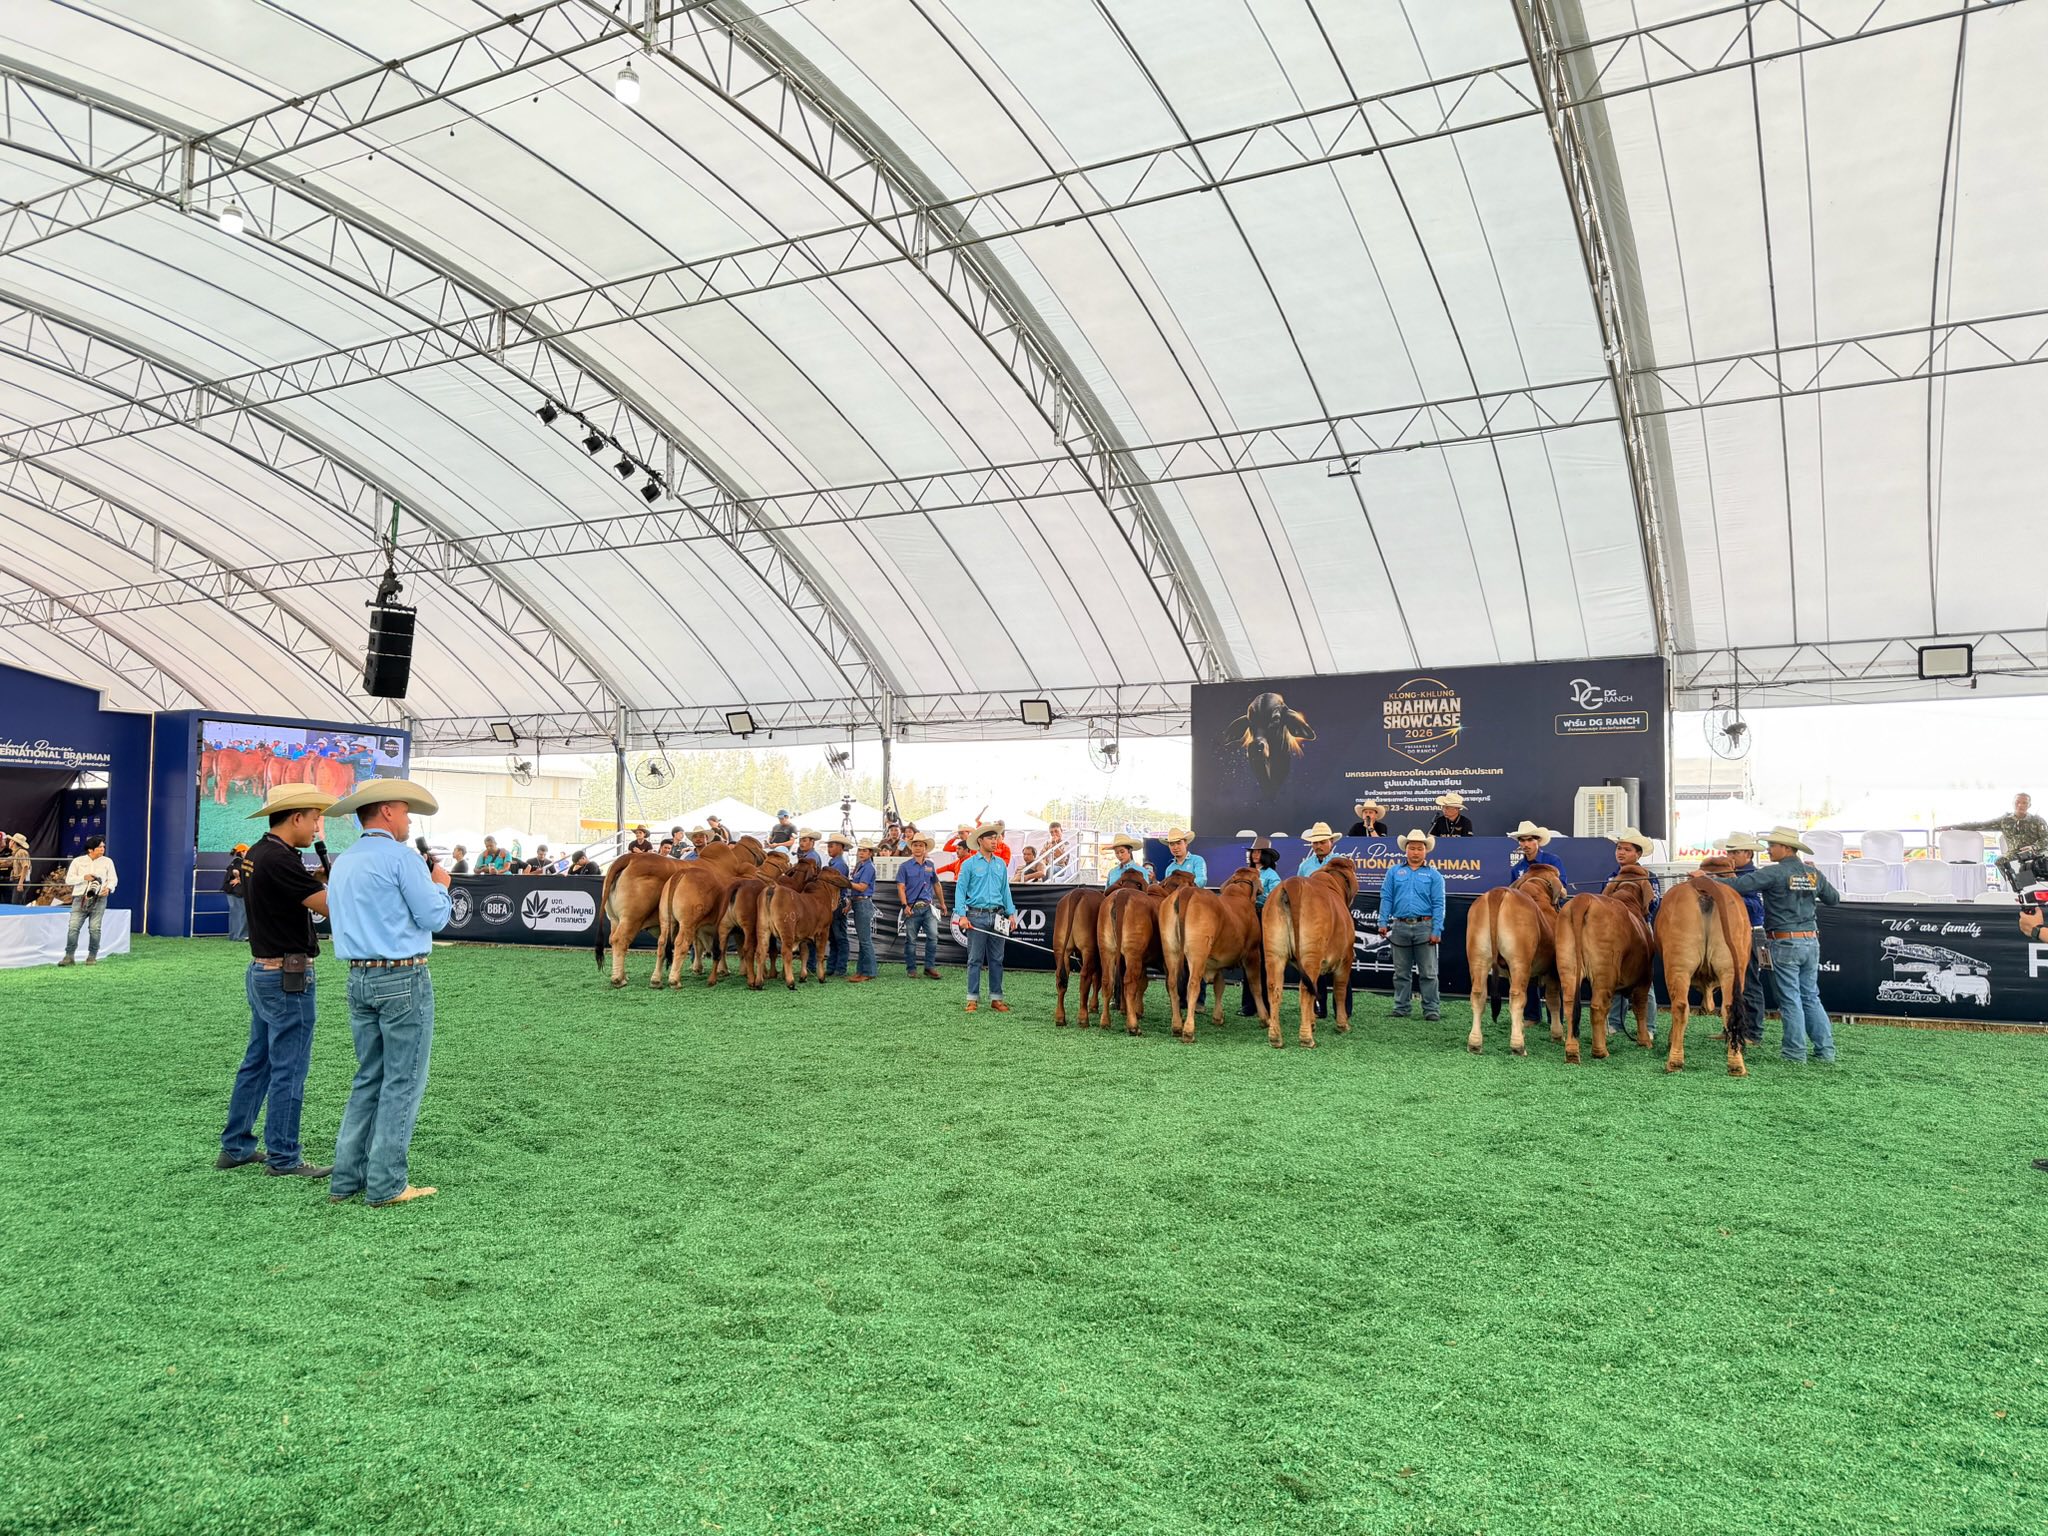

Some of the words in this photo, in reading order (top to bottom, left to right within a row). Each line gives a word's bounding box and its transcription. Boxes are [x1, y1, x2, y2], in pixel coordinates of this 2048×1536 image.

[1388, 689, 1455, 699] KLONG-KHLUNG
[1604, 689, 1617, 697] DG
[1604, 695, 1634, 703] RANCH
[1383, 697, 1461, 716] BRAHMAN
[1383, 713, 1461, 729] SHOWCASE
[1563, 719, 1587, 728] ฟาร์ม
[1589, 718, 1603, 726] DG
[1605, 716, 1640, 726] RANCH
[1404, 729, 1434, 738] 2026
[0, 747, 61, 759] ERNATIONAL
[63, 751, 111, 762] BRAHMAN
[1383, 777, 1462, 789] รูปแบบใหม่ในอาเซียน
[1424, 859, 1481, 870] AHMAN
[487, 903, 508, 915] BBFA
[1919, 923, 1939, 932] are
[1940, 921, 1982, 938] family
